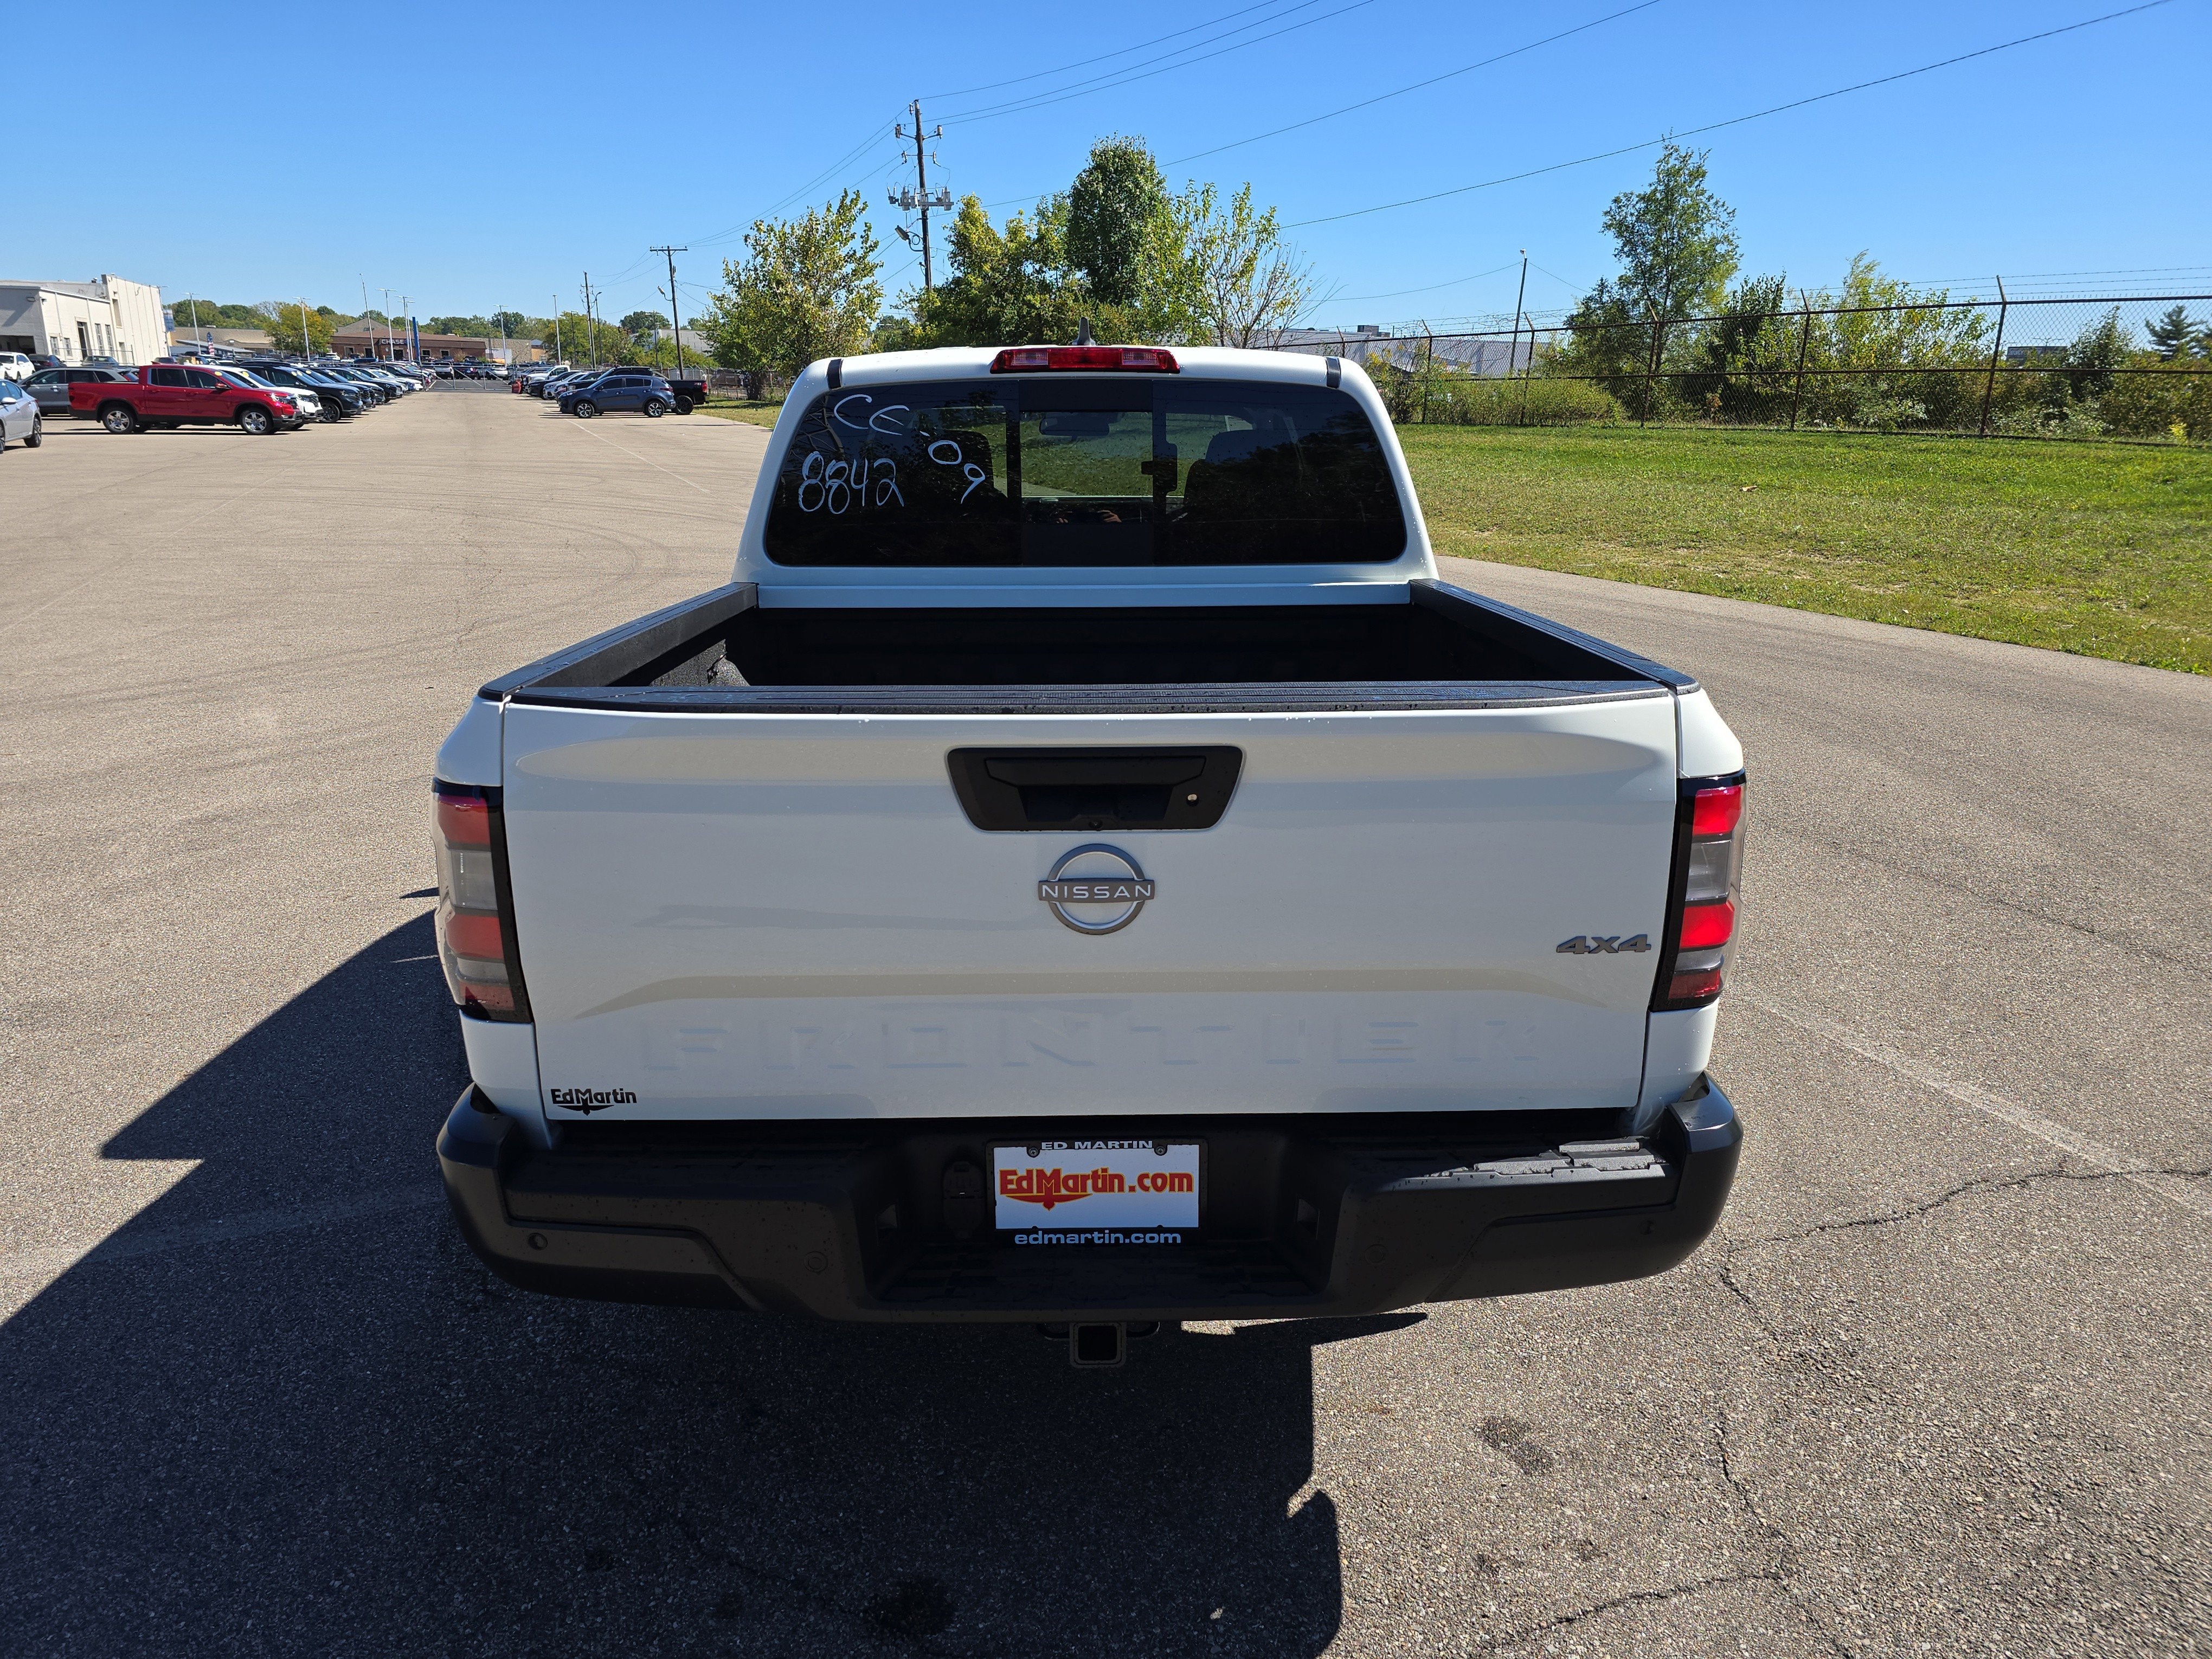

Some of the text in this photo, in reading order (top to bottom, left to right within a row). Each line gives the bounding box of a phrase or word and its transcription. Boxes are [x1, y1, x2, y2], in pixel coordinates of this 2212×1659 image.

[798, 451, 904, 515] 8842
[1041, 884, 1151, 899] NISSAN
[641, 1009, 1541, 1071] FRONTIER
[1041, 1140, 1153, 1150] ED MARTIN
[999, 1167, 1193, 1196] EdMartin.com
[1014, 1230, 1181, 1245] edmartin.com
